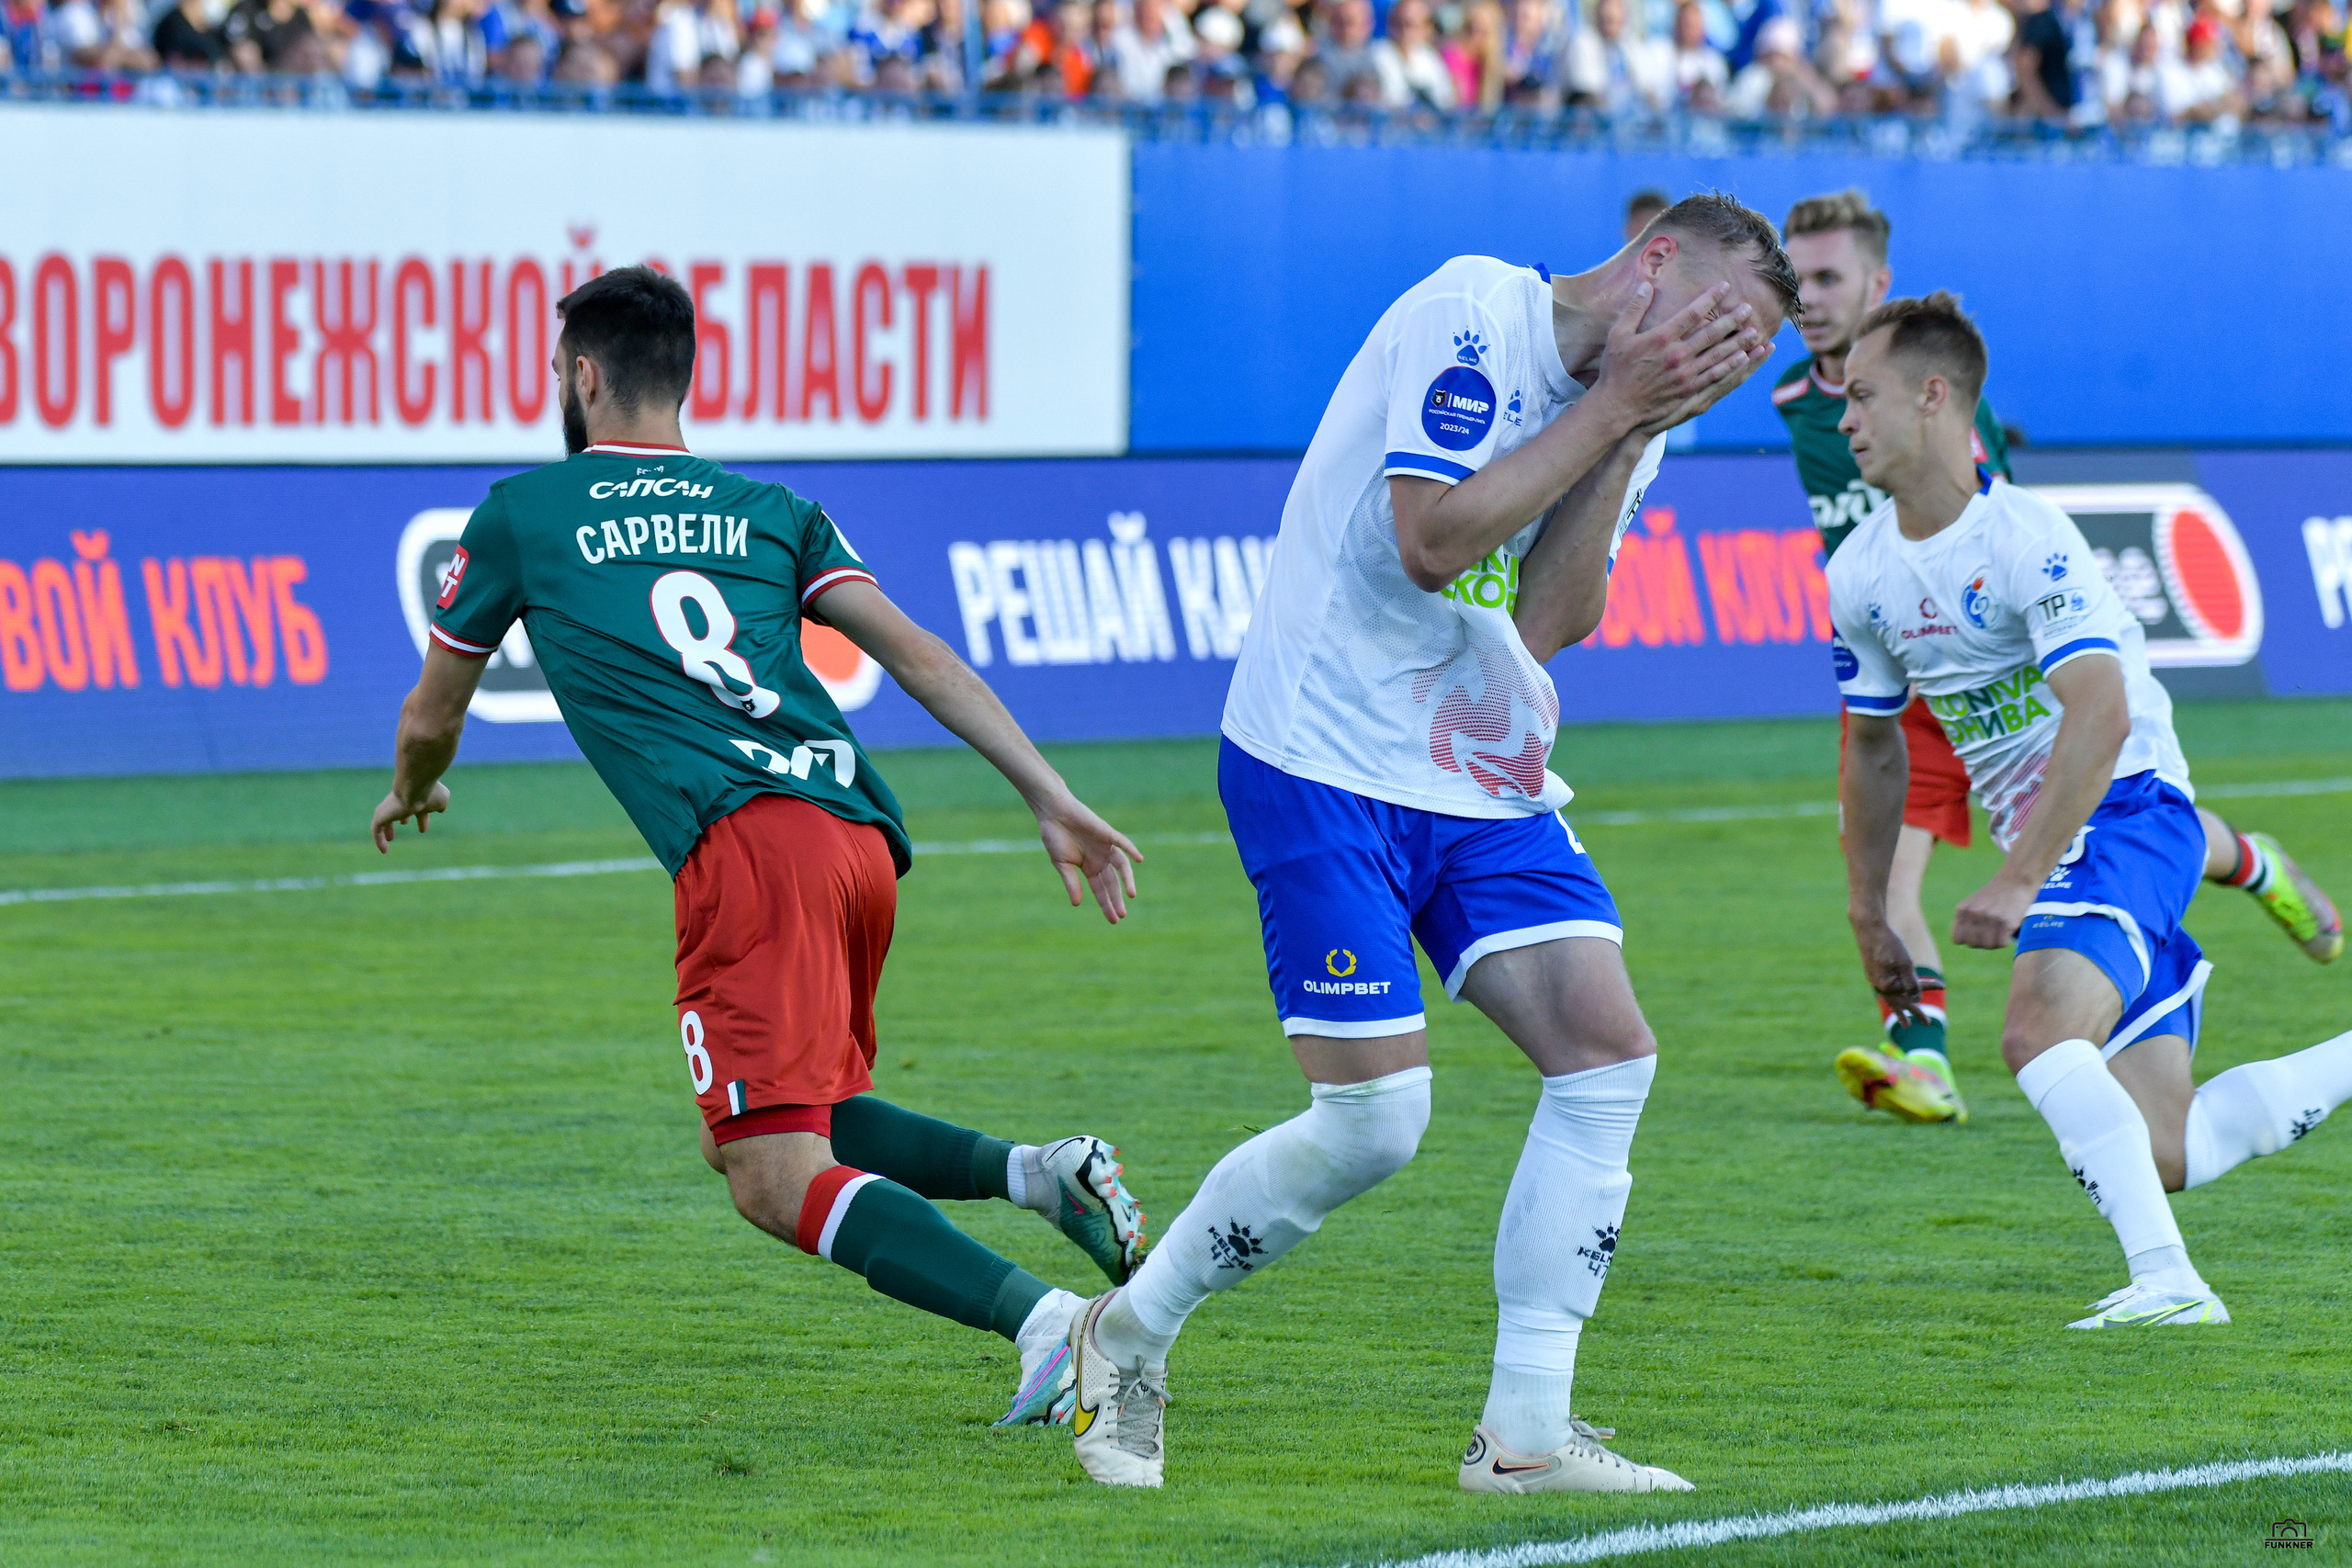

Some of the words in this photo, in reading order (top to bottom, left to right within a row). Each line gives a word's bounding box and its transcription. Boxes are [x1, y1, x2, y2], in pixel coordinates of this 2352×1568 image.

[645, 257, 990, 424] БЛАСТИ
[1439, 422, 1470, 435] 2023/24
[1452, 395, 1489, 414] МИР
[589, 478, 714, 500] САПСАН
[575, 513, 749, 565] САРВЕЛИ
[947, 510, 1178, 669] РЕШАЙ
[141, 555, 330, 689] КЛУБ
[649, 569, 781, 719] 8
[1303, 979, 1391, 996] OLIMPBET
[680, 1010, 714, 1096] 8
[1207, 1225, 1254, 1271] KELME
[1588, 1260, 1610, 1280] 47
